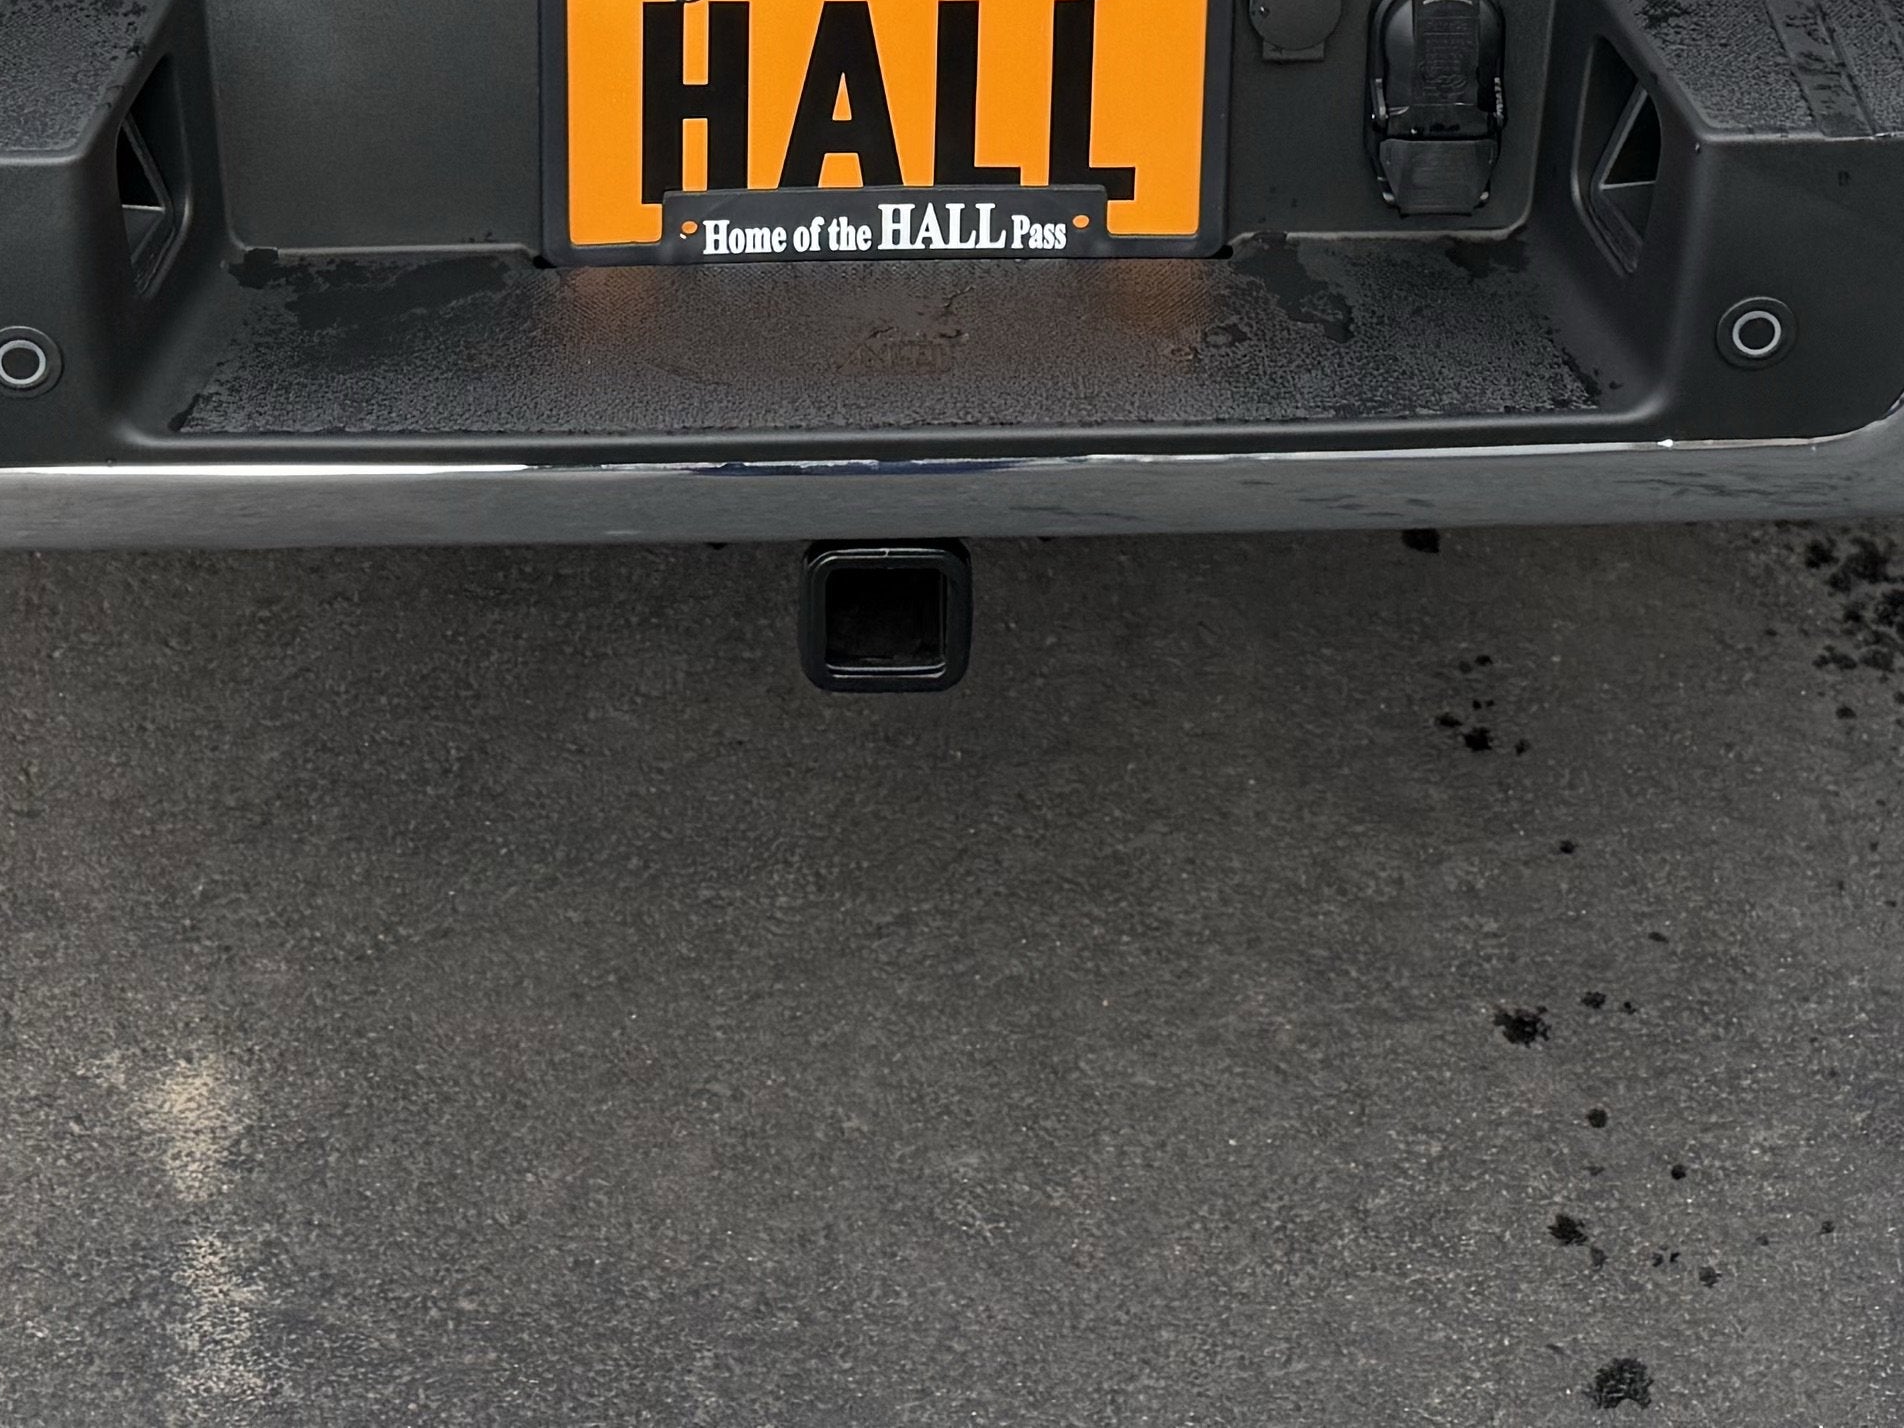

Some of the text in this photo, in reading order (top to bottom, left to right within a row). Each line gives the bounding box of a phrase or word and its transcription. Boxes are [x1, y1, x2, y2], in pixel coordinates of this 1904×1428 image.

[702, 201, 1068, 256] Home of the HALL Pass
